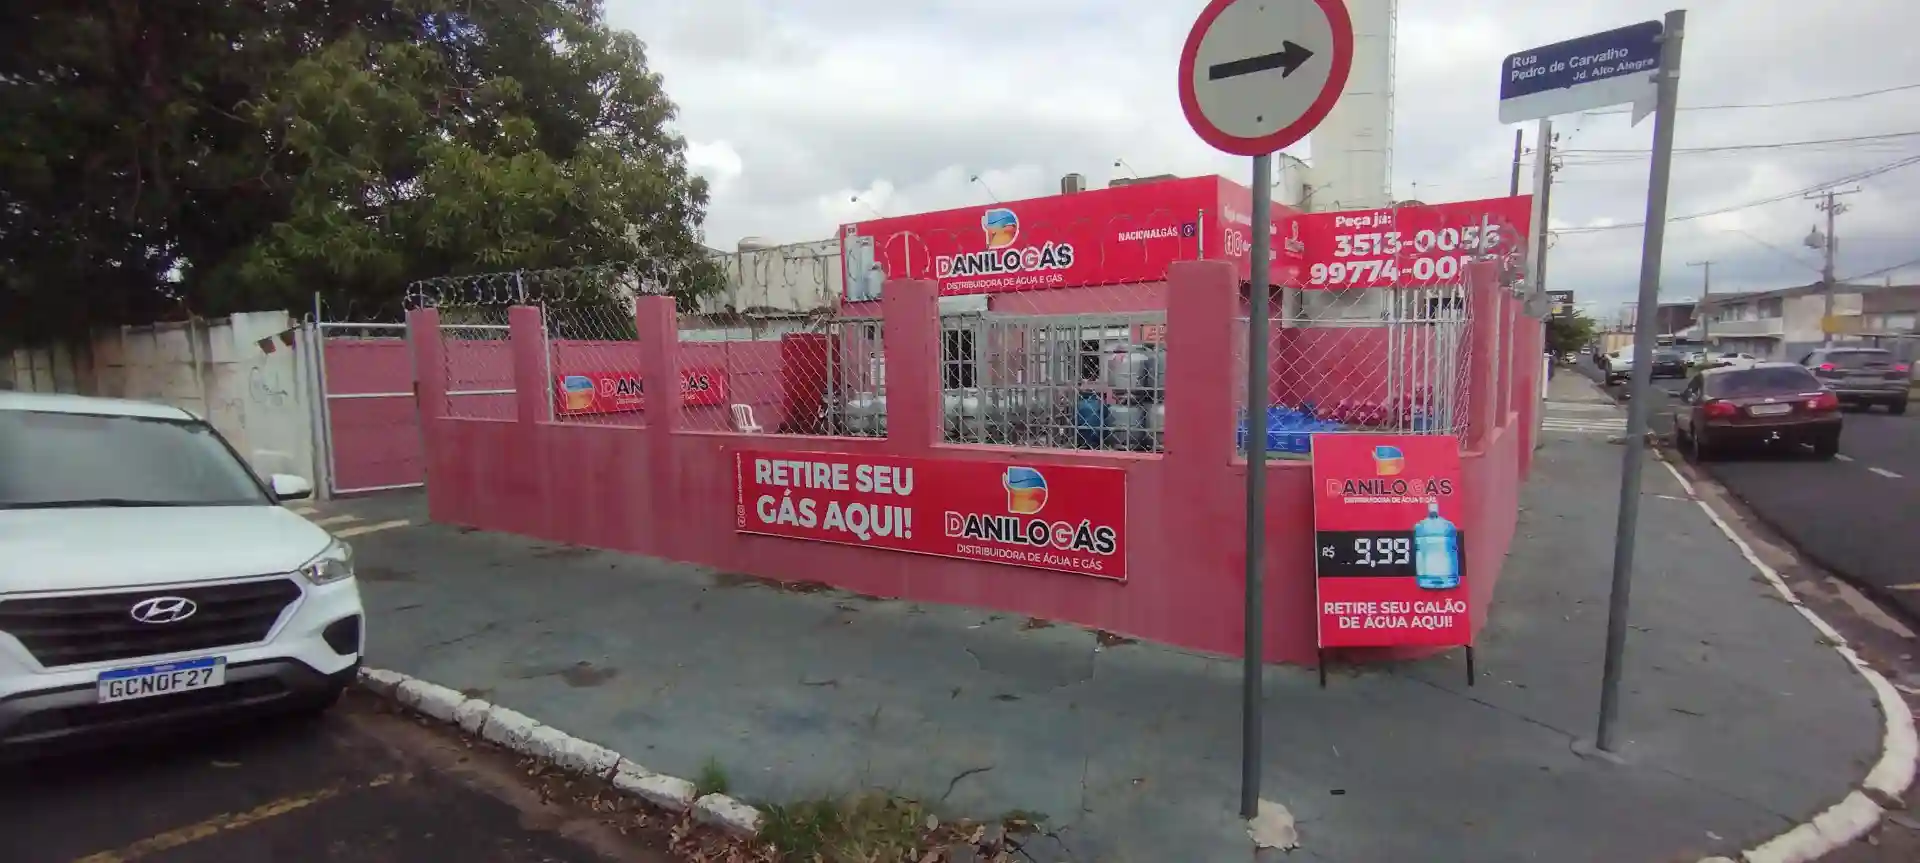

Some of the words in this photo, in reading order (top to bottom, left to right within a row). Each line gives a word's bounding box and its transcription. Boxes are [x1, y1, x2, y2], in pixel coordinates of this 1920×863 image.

[1511, 66, 1546, 82] Pedro
[1549, 60, 1565, 72] de
[1569, 47, 1629, 69] Carvalho
[1512, 55, 1537, 68] Rua
[1591, 66, 1615, 77] Alto
[1616, 58, 1654, 71] Alegre
[1335, 215, 1371, 229] Peça
[1372, 211, 1392, 227] já:
[1118, 223, 1178, 242] NACIONALGÁS
[936, 241, 1074, 279] DANILOGÁS
[946, 279, 1002, 291] DISTRIBUIDORA
[1003, 278, 1015, 286] DE
[1016, 275, 1038, 285] ÁGUA
[1040, 276, 1045, 284] E
[1046, 273, 1063, 283] GÁS
[755, 458, 850, 490] RETIRE
[855, 464, 914, 496] SEU
[1326, 476, 1453, 497] DANILOGÁS
[756, 488, 818, 528] GÁS
[822, 500, 912, 541] AQUI!
[945, 511, 1117, 555] DANILOGÁS
[956, 543, 1026, 561] DISTRIBUIDORA
[1027, 552, 1041, 563] DE
[1042, 552, 1071, 567] ÁGUA
[1072, 557, 1080, 567] E
[1081, 558, 1103, 571] GÁS
[1322, 544, 1336, 559] R$
[1354, 538, 1410, 568] 9,99
[1324, 601, 1377, 614] RETIRE
[1380, 601, 1410, 614] SEU
[1413, 598, 1467, 614] GALÃO
[1339, 616, 1361, 629] DE
[1364, 614, 1409, 629] ÁGUA
[1411, 615, 1453, 630] AQUI!
